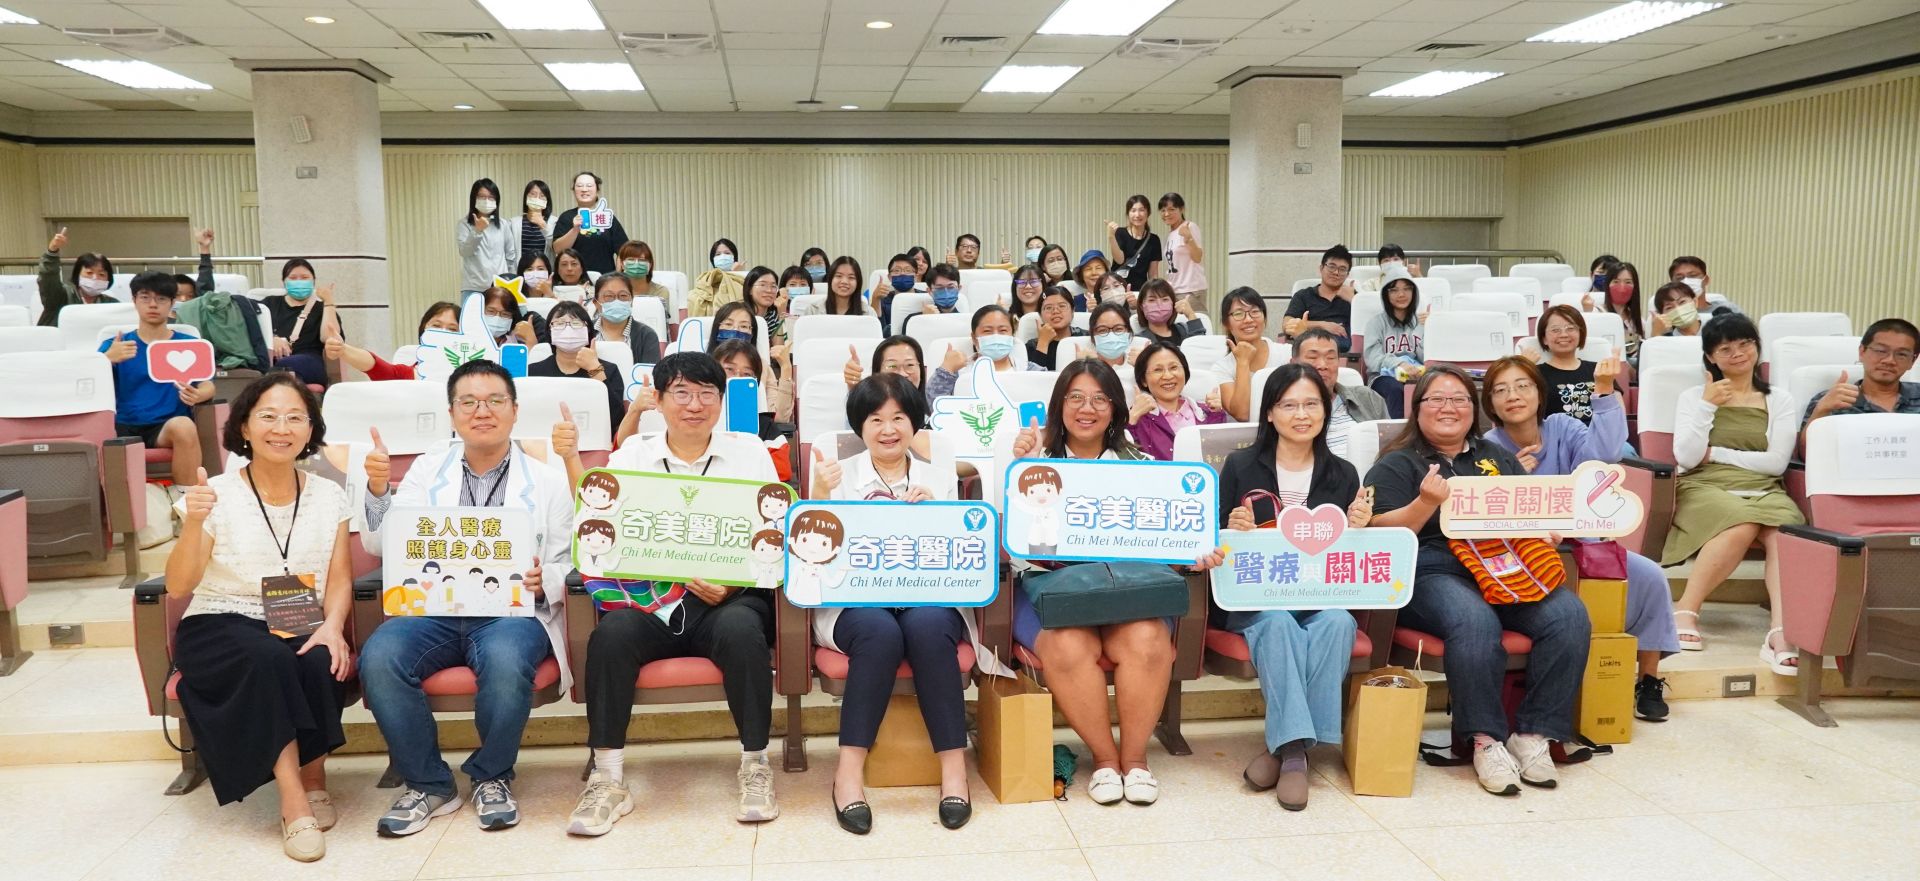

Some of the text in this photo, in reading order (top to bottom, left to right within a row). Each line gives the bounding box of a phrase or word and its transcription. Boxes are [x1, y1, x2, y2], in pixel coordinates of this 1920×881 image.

[595, 213, 607, 225] 推
[1451, 485, 1574, 516] 社會關懷
[1065, 495, 1205, 531] 奇美醫院
[416, 517, 502, 537] 全人醫療
[621, 509, 751, 548] 奇美醫院
[1293, 521, 1334, 541] 串聯
[1483, 520, 1540, 529] SOCIAL CARE
[1576, 519, 1616, 530] Chi Mei
[406, 540, 512, 560] 照護身心靈
[1066, 534, 1200, 549] Chi Mei Medical Center
[621, 546, 746, 564] Chi Mei Medical Center
[848, 534, 986, 571] 奇美醫院
[850, 576, 981, 587] Chi Mei Medical Center
[1264, 588, 1361, 597] Chi Mei Medical Center
